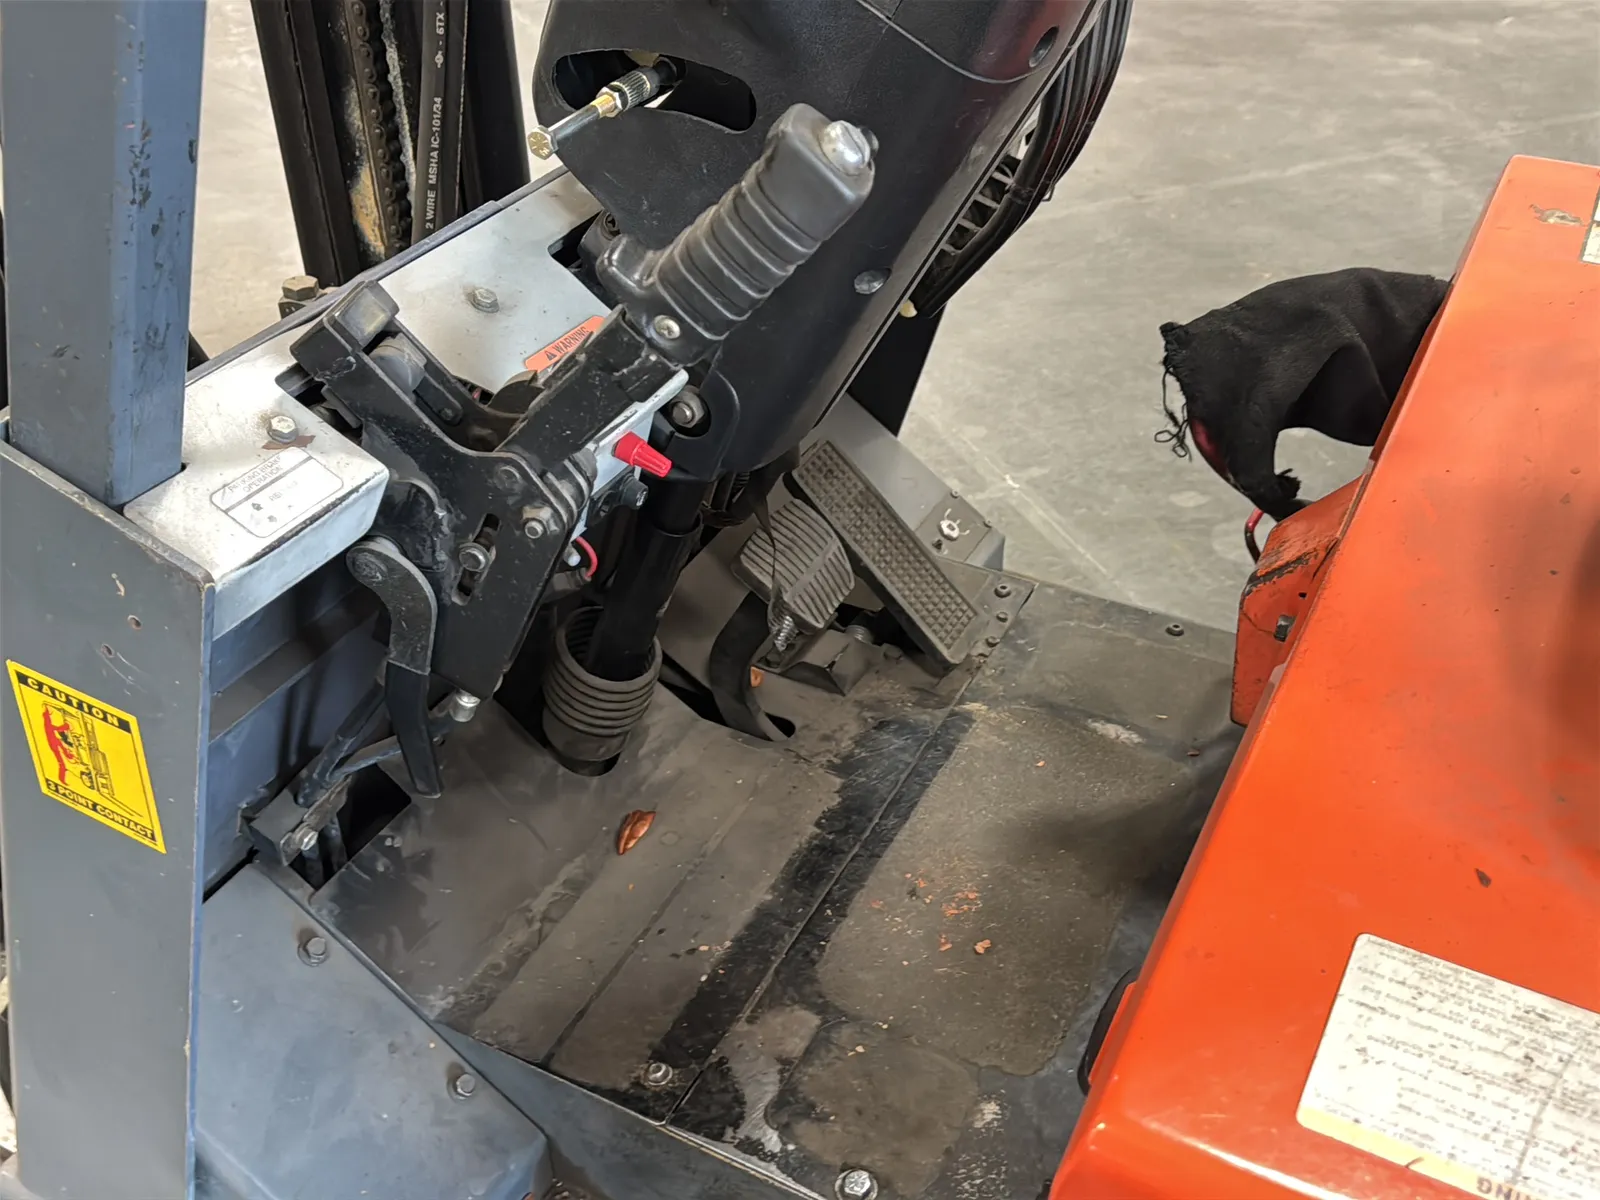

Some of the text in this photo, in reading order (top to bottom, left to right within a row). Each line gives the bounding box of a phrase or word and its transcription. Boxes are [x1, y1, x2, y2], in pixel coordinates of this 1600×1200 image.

[425, 97, 443, 230] 2 WIRE MSHA IC-101/34
[242, 464, 284, 492] OPERATION
[27, 678, 120, 727] CAUTION
[46, 780, 57, 791] 3
[57, 786, 95, 810] POINT
[95, 804, 155, 839] CONTACT
